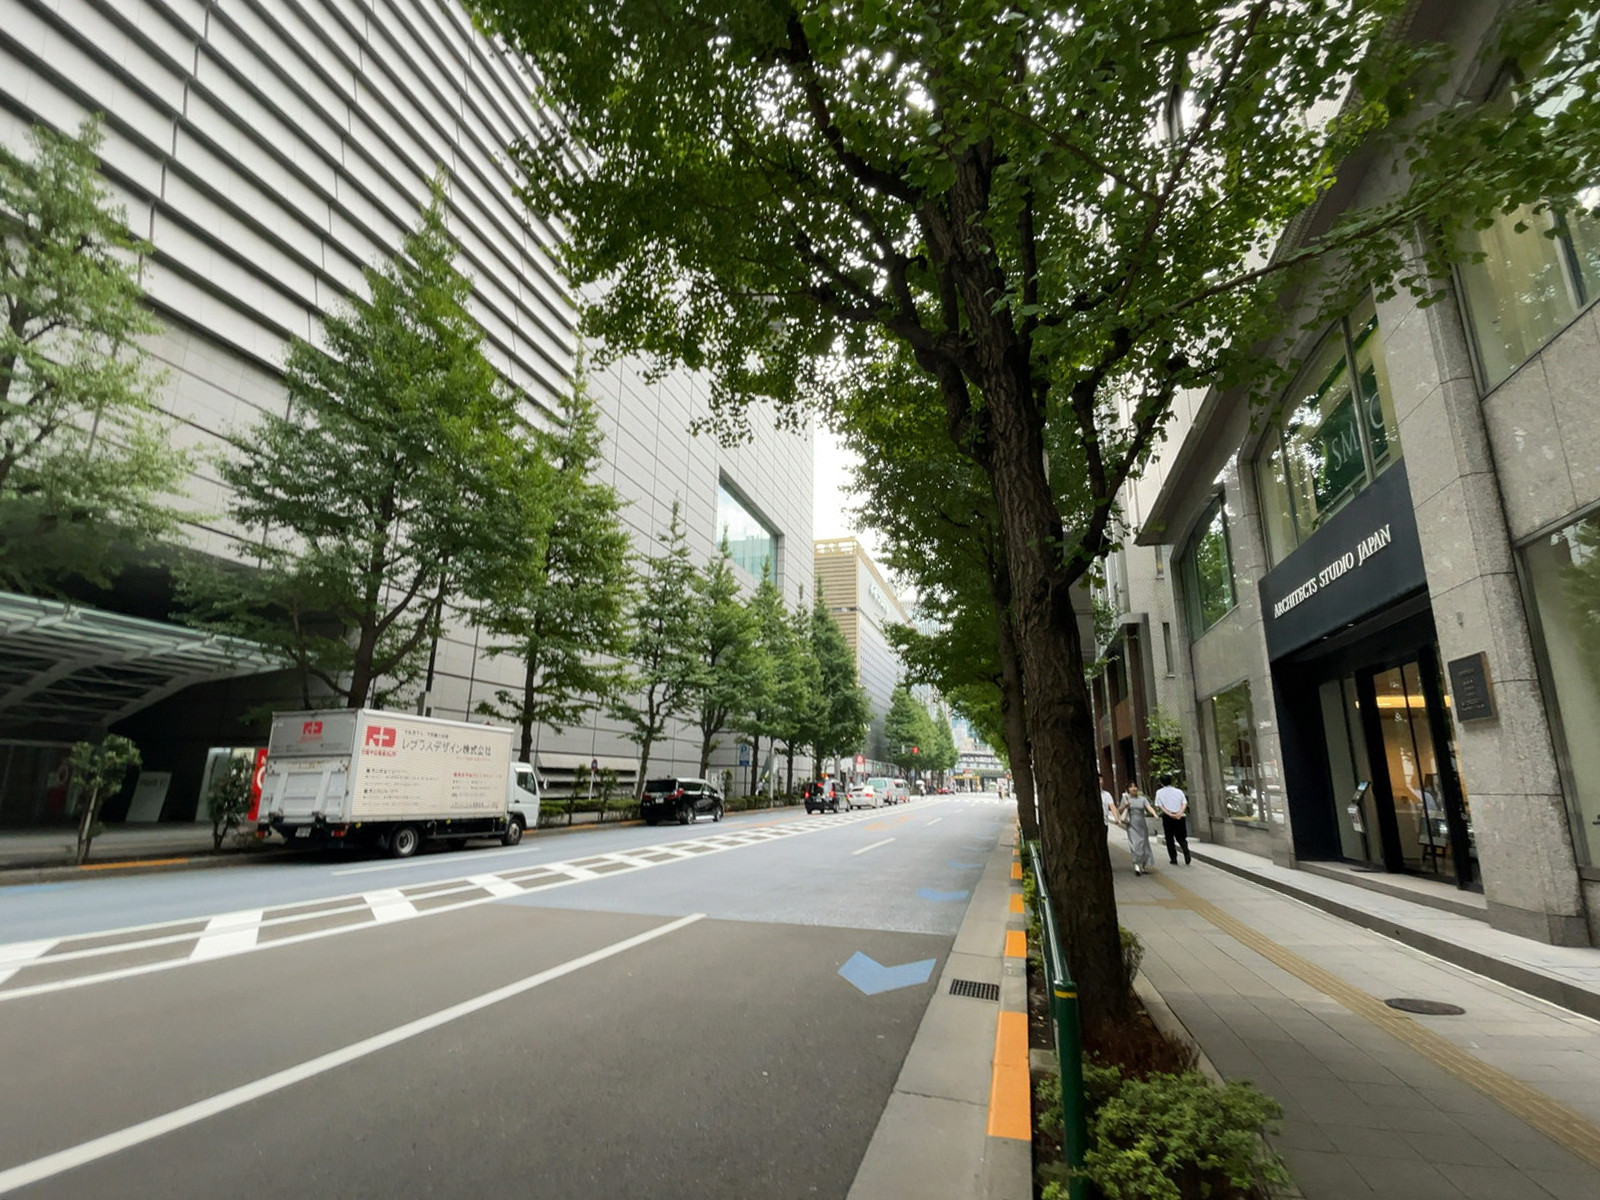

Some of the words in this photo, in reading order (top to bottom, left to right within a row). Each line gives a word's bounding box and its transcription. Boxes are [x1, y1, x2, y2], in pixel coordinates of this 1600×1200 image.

[1274, 577, 1318, 619] ARCHITECTS
[1319, 552, 1355, 588] STUDIO
[1357, 523, 1392, 566] JAPAN
